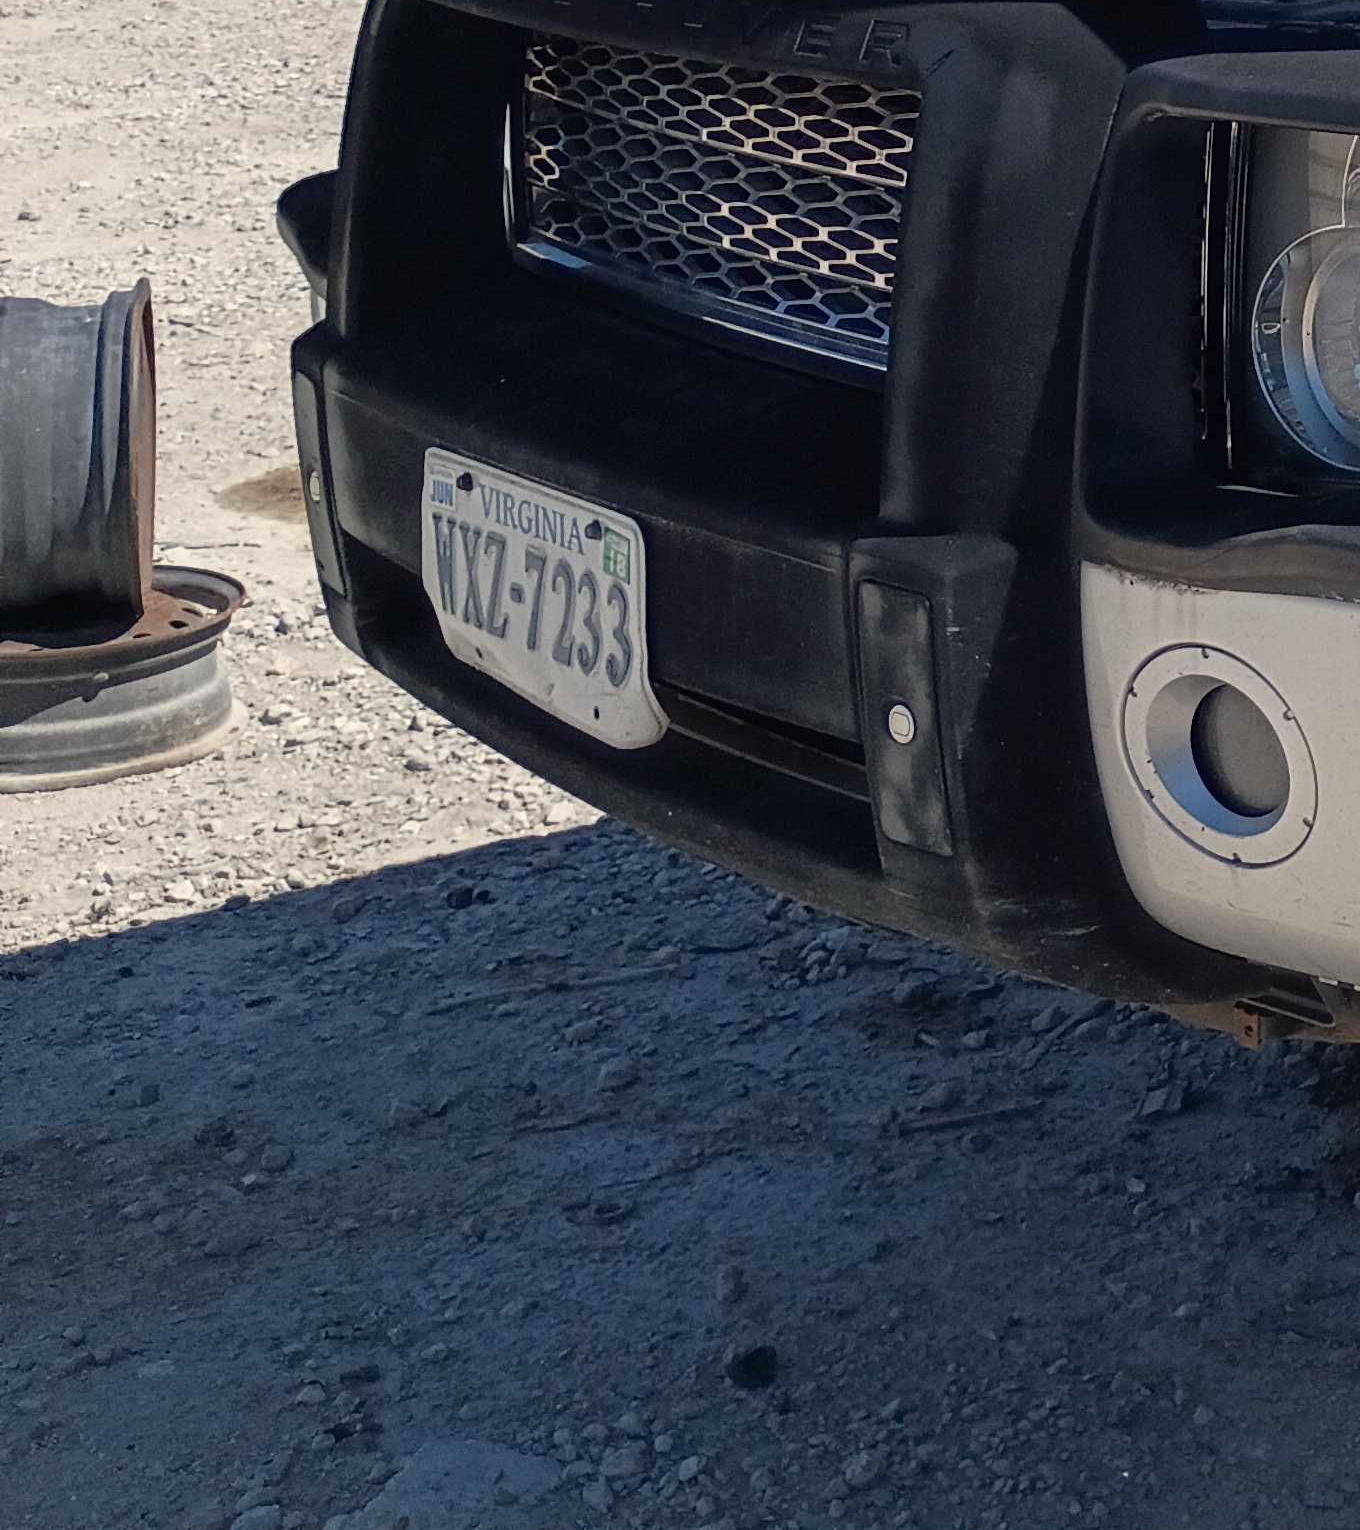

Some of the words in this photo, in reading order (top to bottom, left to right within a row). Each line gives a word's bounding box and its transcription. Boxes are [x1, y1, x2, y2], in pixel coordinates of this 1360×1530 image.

[430, 479, 454, 507] JUN
[478, 483, 586, 556] VIRGINIA
[432, 512, 634, 687] WXZ-7233
